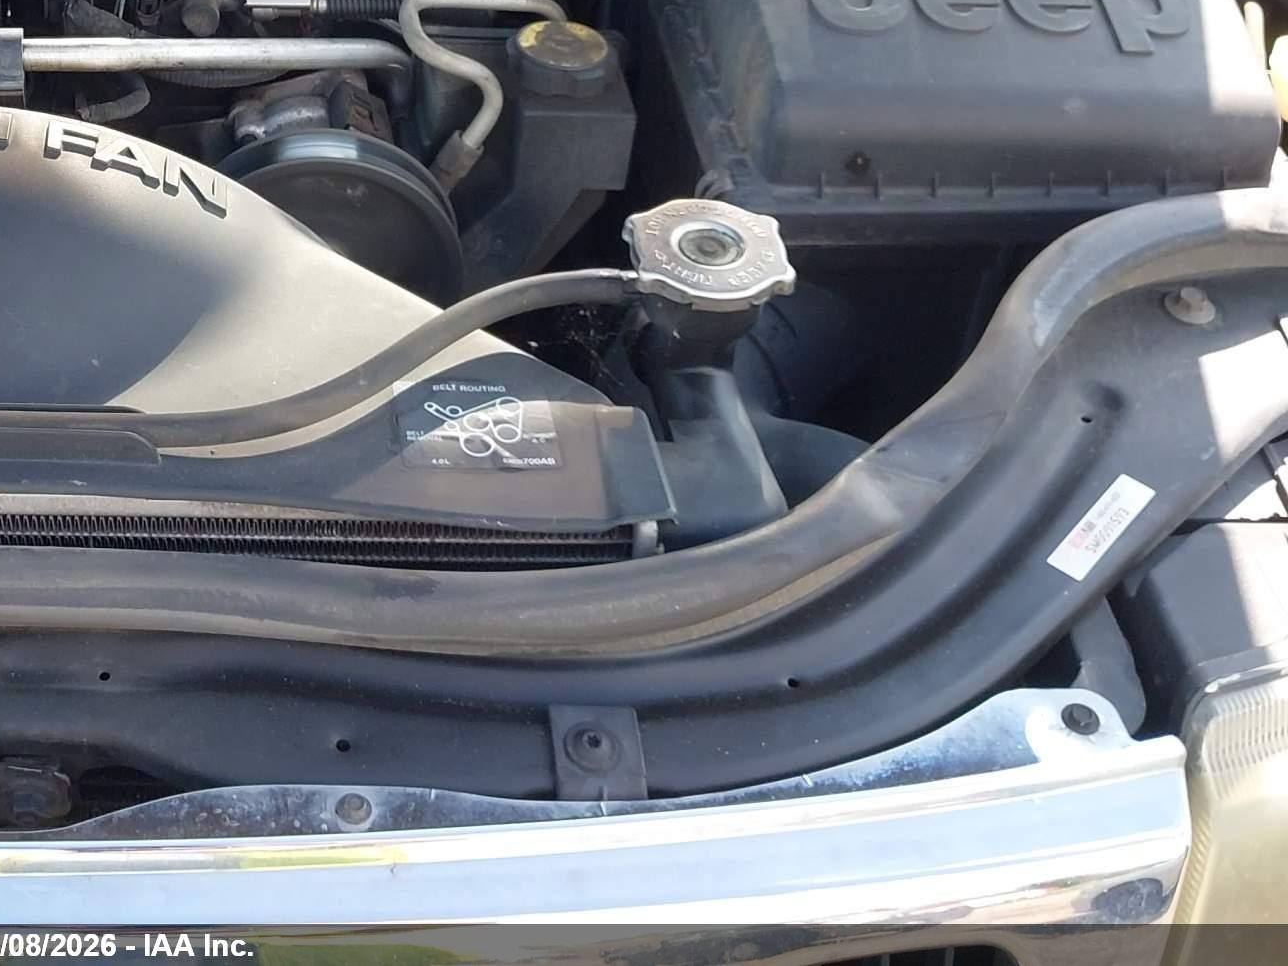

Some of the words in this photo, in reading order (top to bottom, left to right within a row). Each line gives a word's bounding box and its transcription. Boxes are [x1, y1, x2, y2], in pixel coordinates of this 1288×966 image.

[43, 119, 229, 220] FAN
[432, 384, 457, 392] BELT
[459, 384, 506, 393] ROUTING
